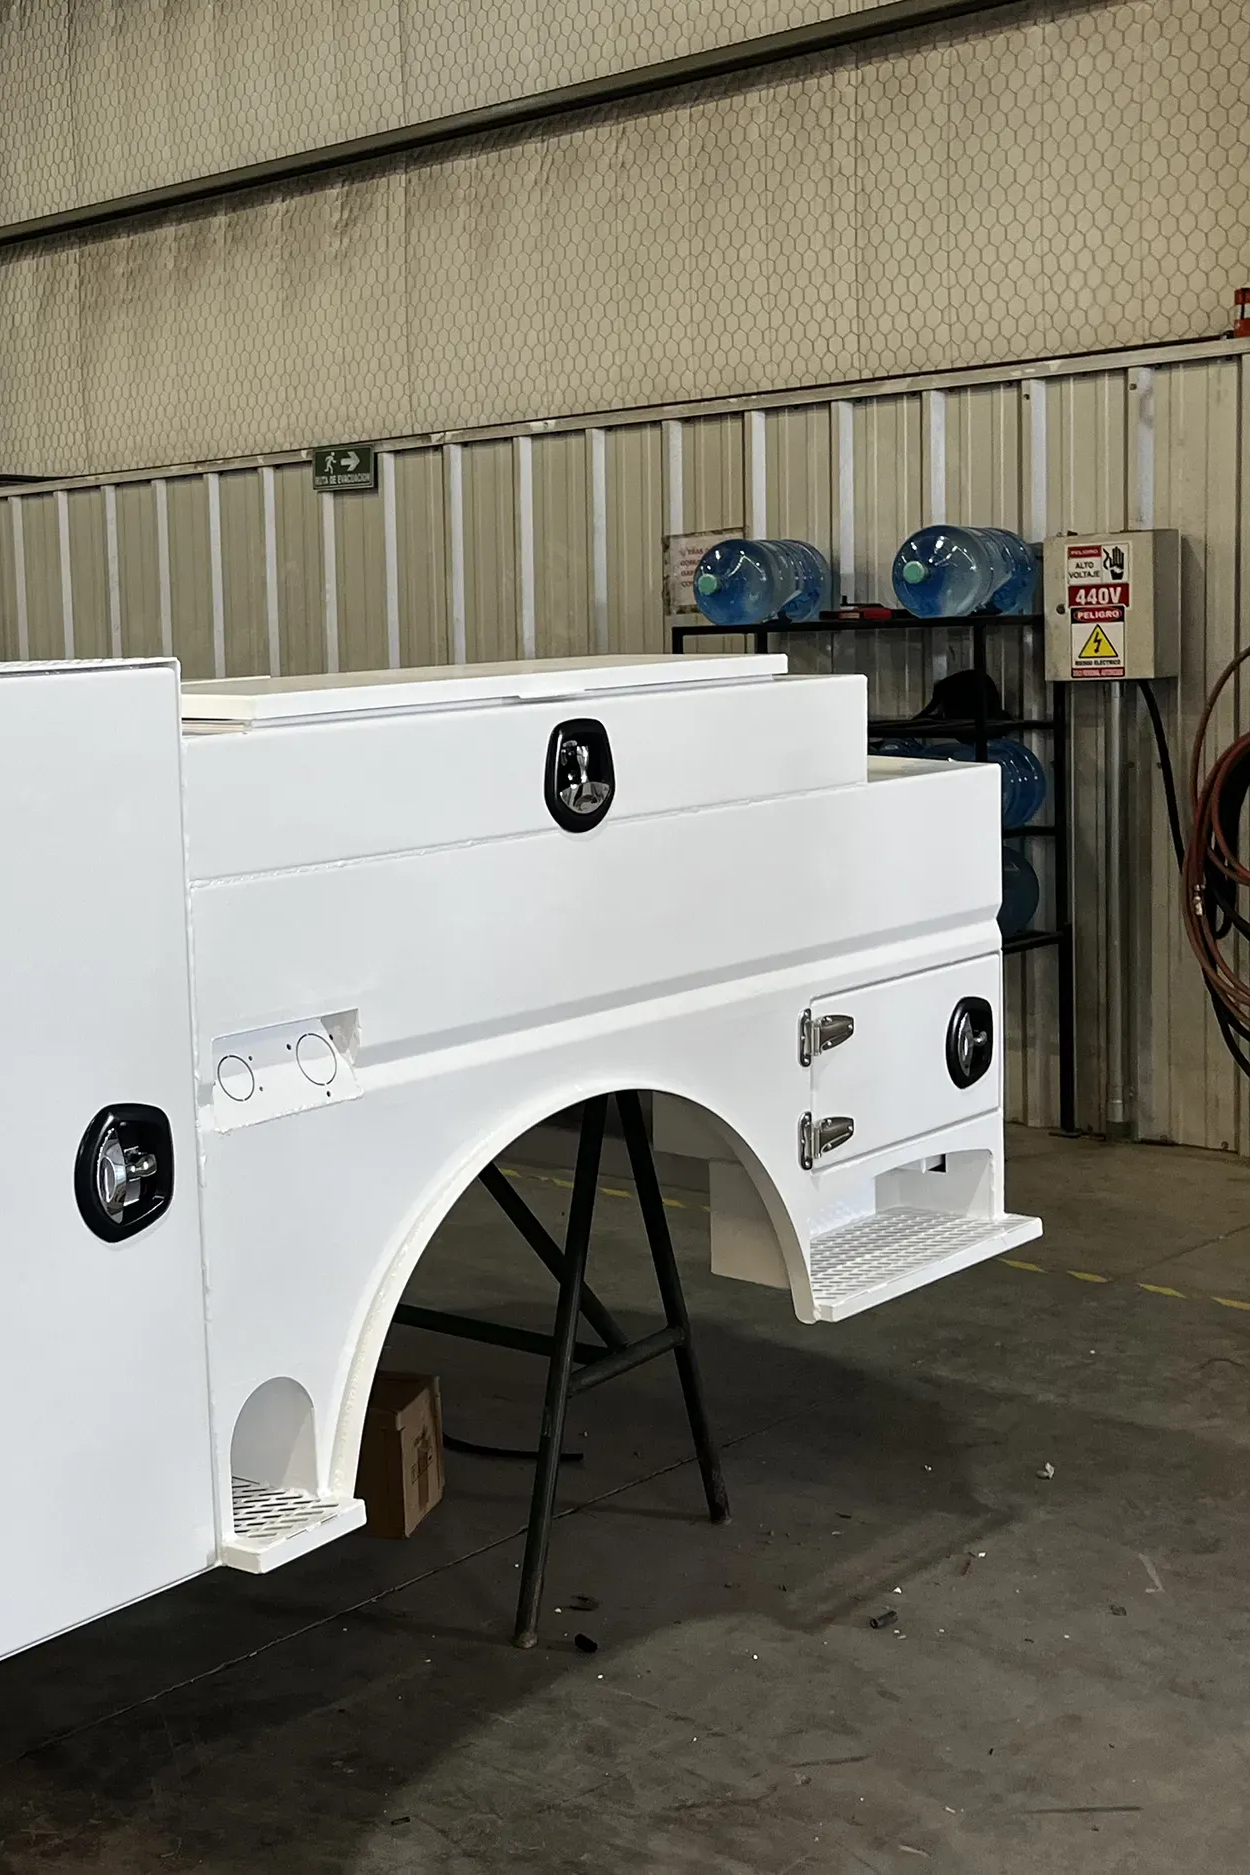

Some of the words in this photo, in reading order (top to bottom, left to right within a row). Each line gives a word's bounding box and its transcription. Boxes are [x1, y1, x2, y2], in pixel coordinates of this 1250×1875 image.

[1075, 561, 1094, 569] ALTO
[1068, 570, 1100, 579] VOLTAJE
[1075, 587, 1122, 605] 440V
[1077, 610, 1120, 620] PELIGRO
